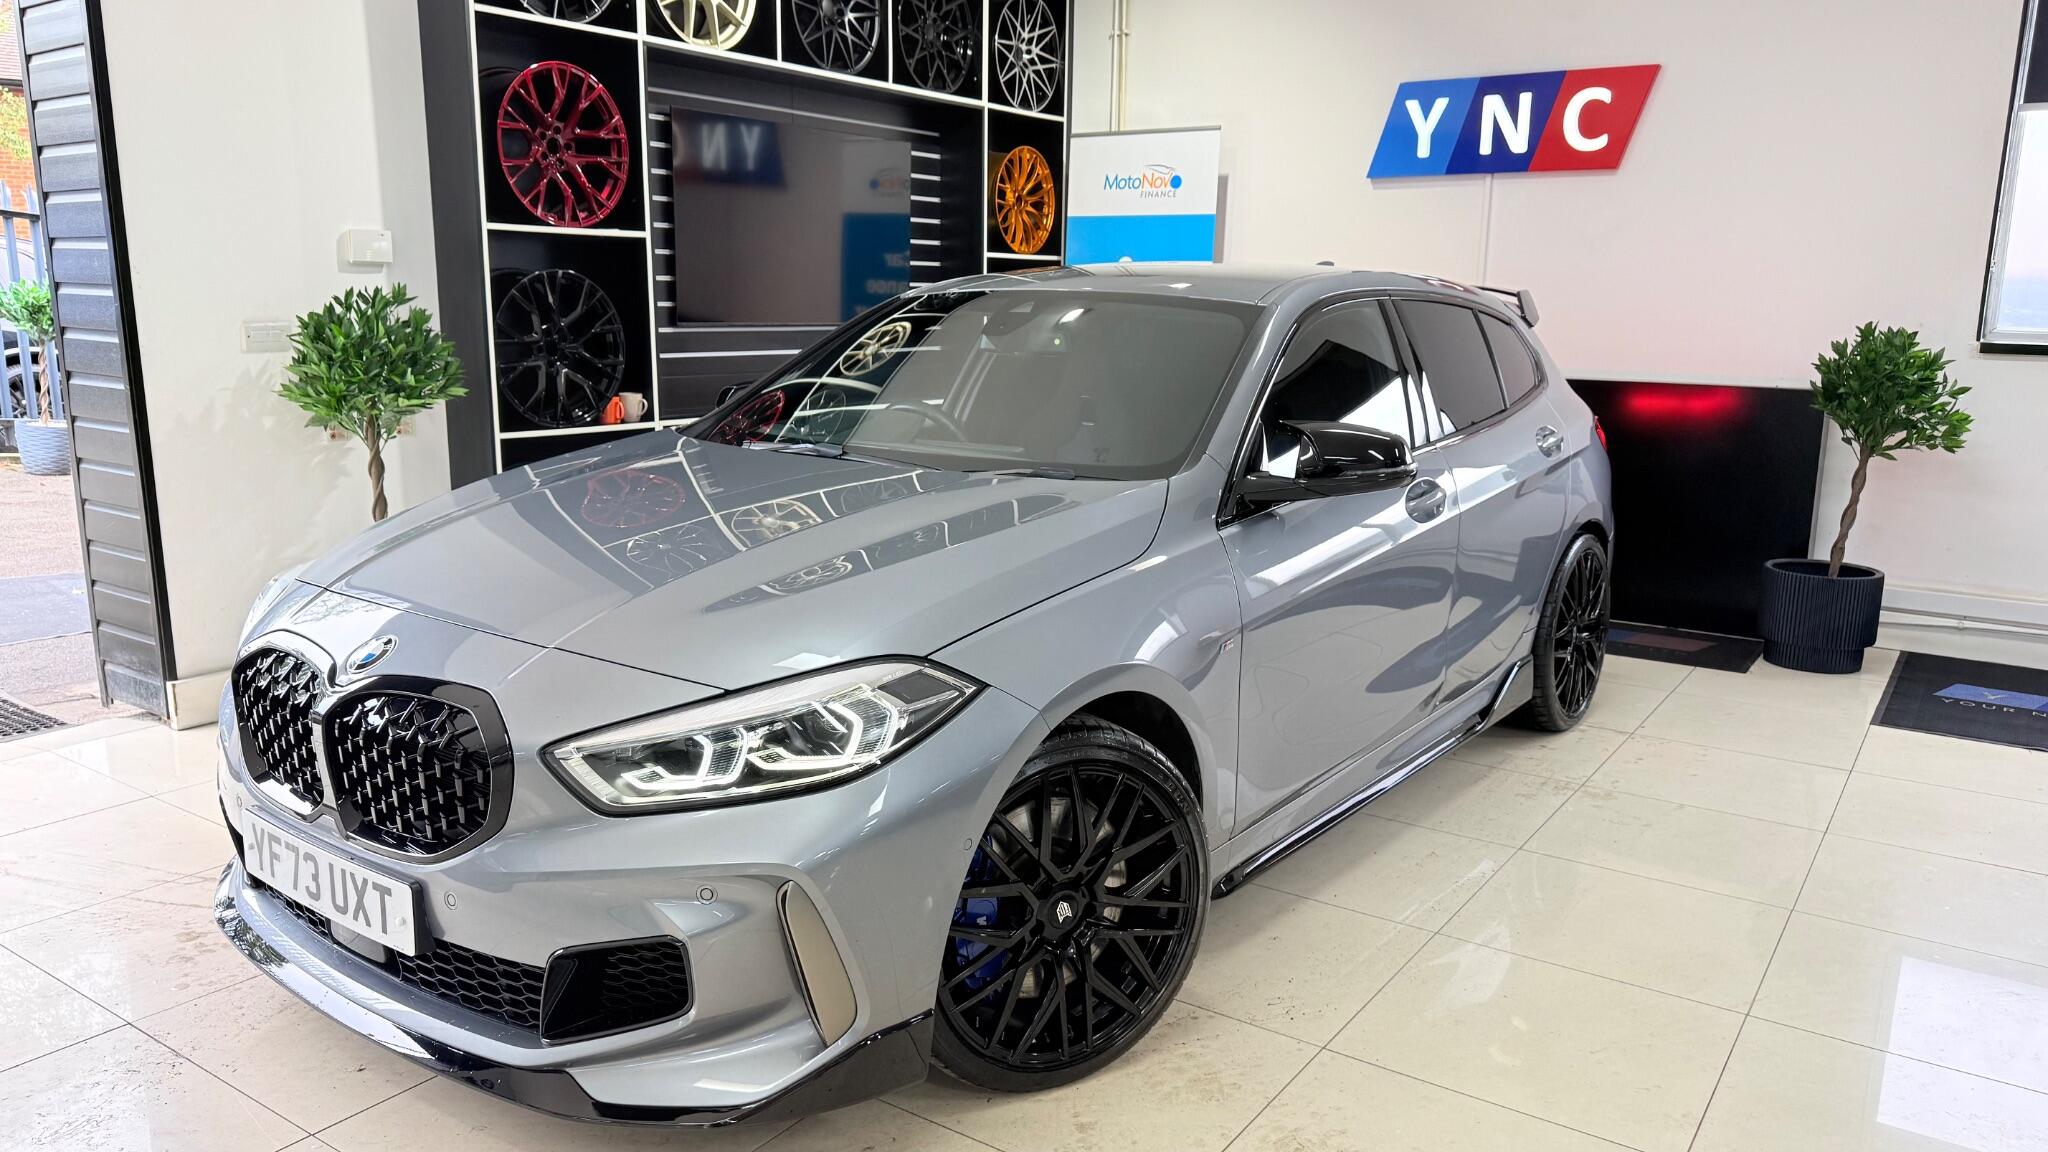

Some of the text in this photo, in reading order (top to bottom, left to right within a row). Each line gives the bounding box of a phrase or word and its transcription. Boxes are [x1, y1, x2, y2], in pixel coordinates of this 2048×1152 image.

[1404, 86, 1612, 159] YNC
[1140, 189, 1177, 198] FINANCE
[1941, 698, 2015, 712] YOUR
[252, 823, 393, 935] YF73 UXT
